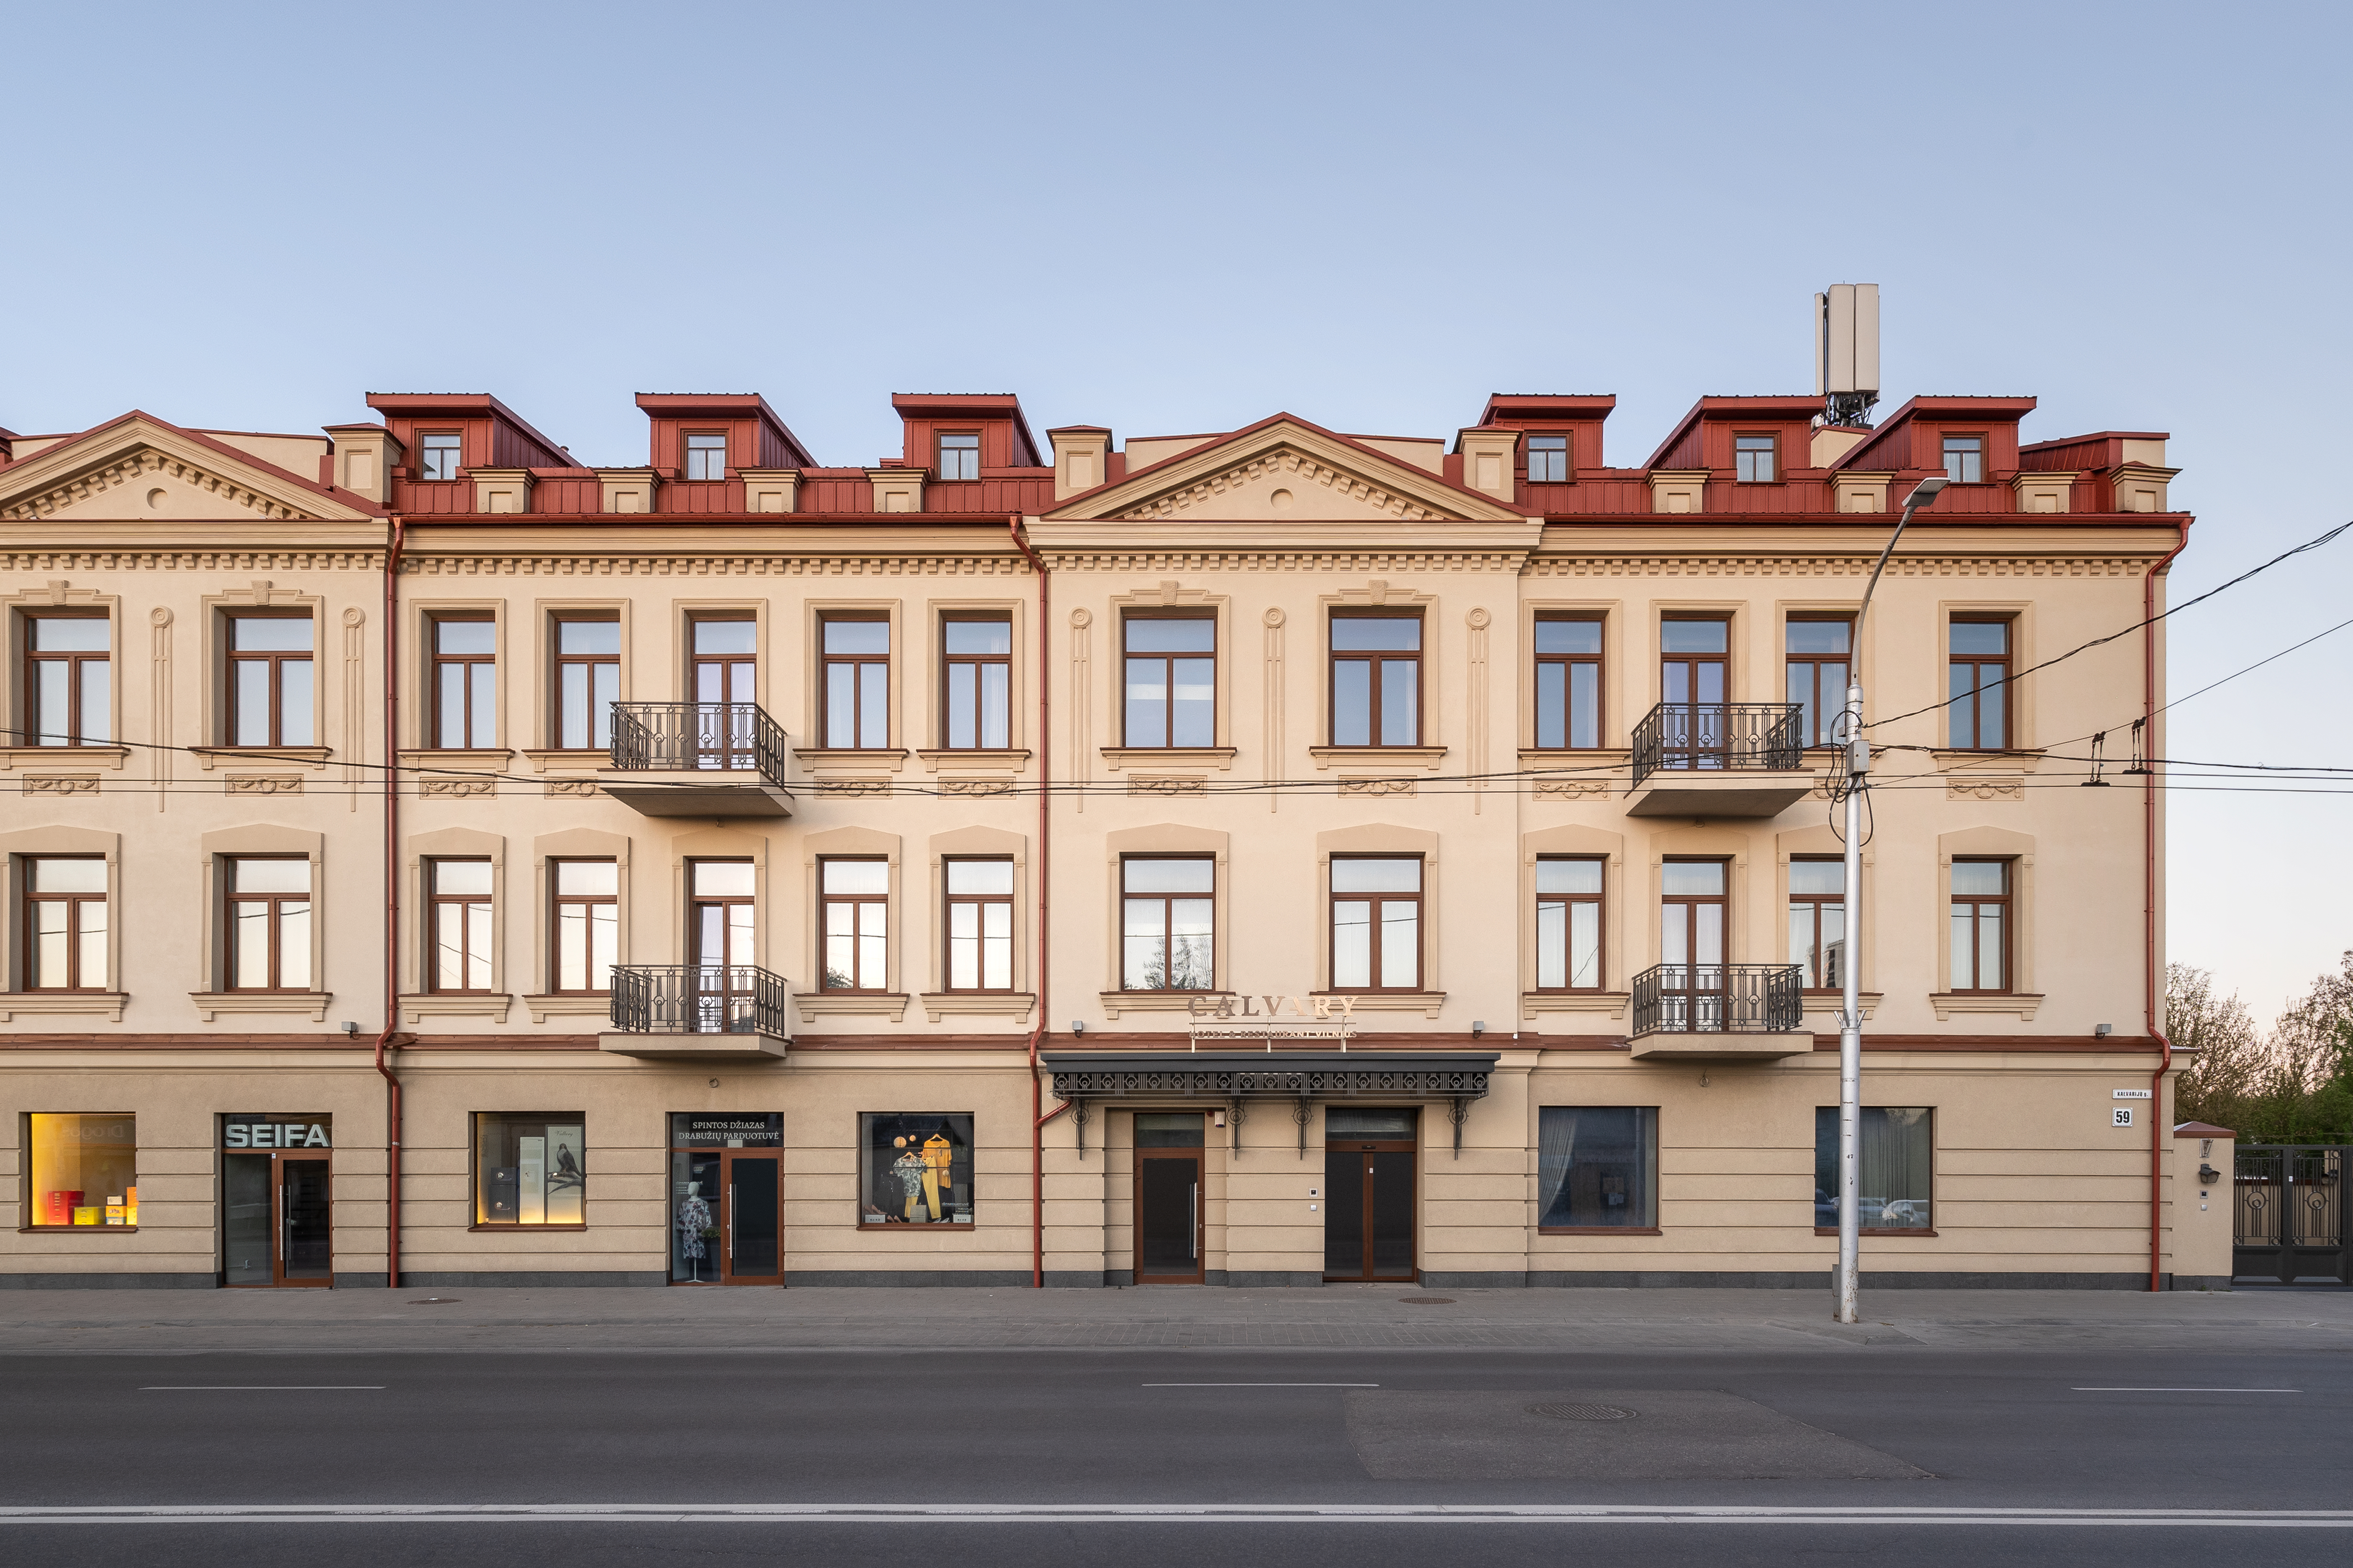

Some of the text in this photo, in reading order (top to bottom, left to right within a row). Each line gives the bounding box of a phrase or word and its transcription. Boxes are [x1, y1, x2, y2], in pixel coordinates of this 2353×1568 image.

[1188, 996, 1358, 1017] CALVARY
[2116, 1111, 2130, 1123] 59
[226, 1124, 332, 1147] SEIFA
[679, 1131, 721, 1141] DRABUŽIŲ
